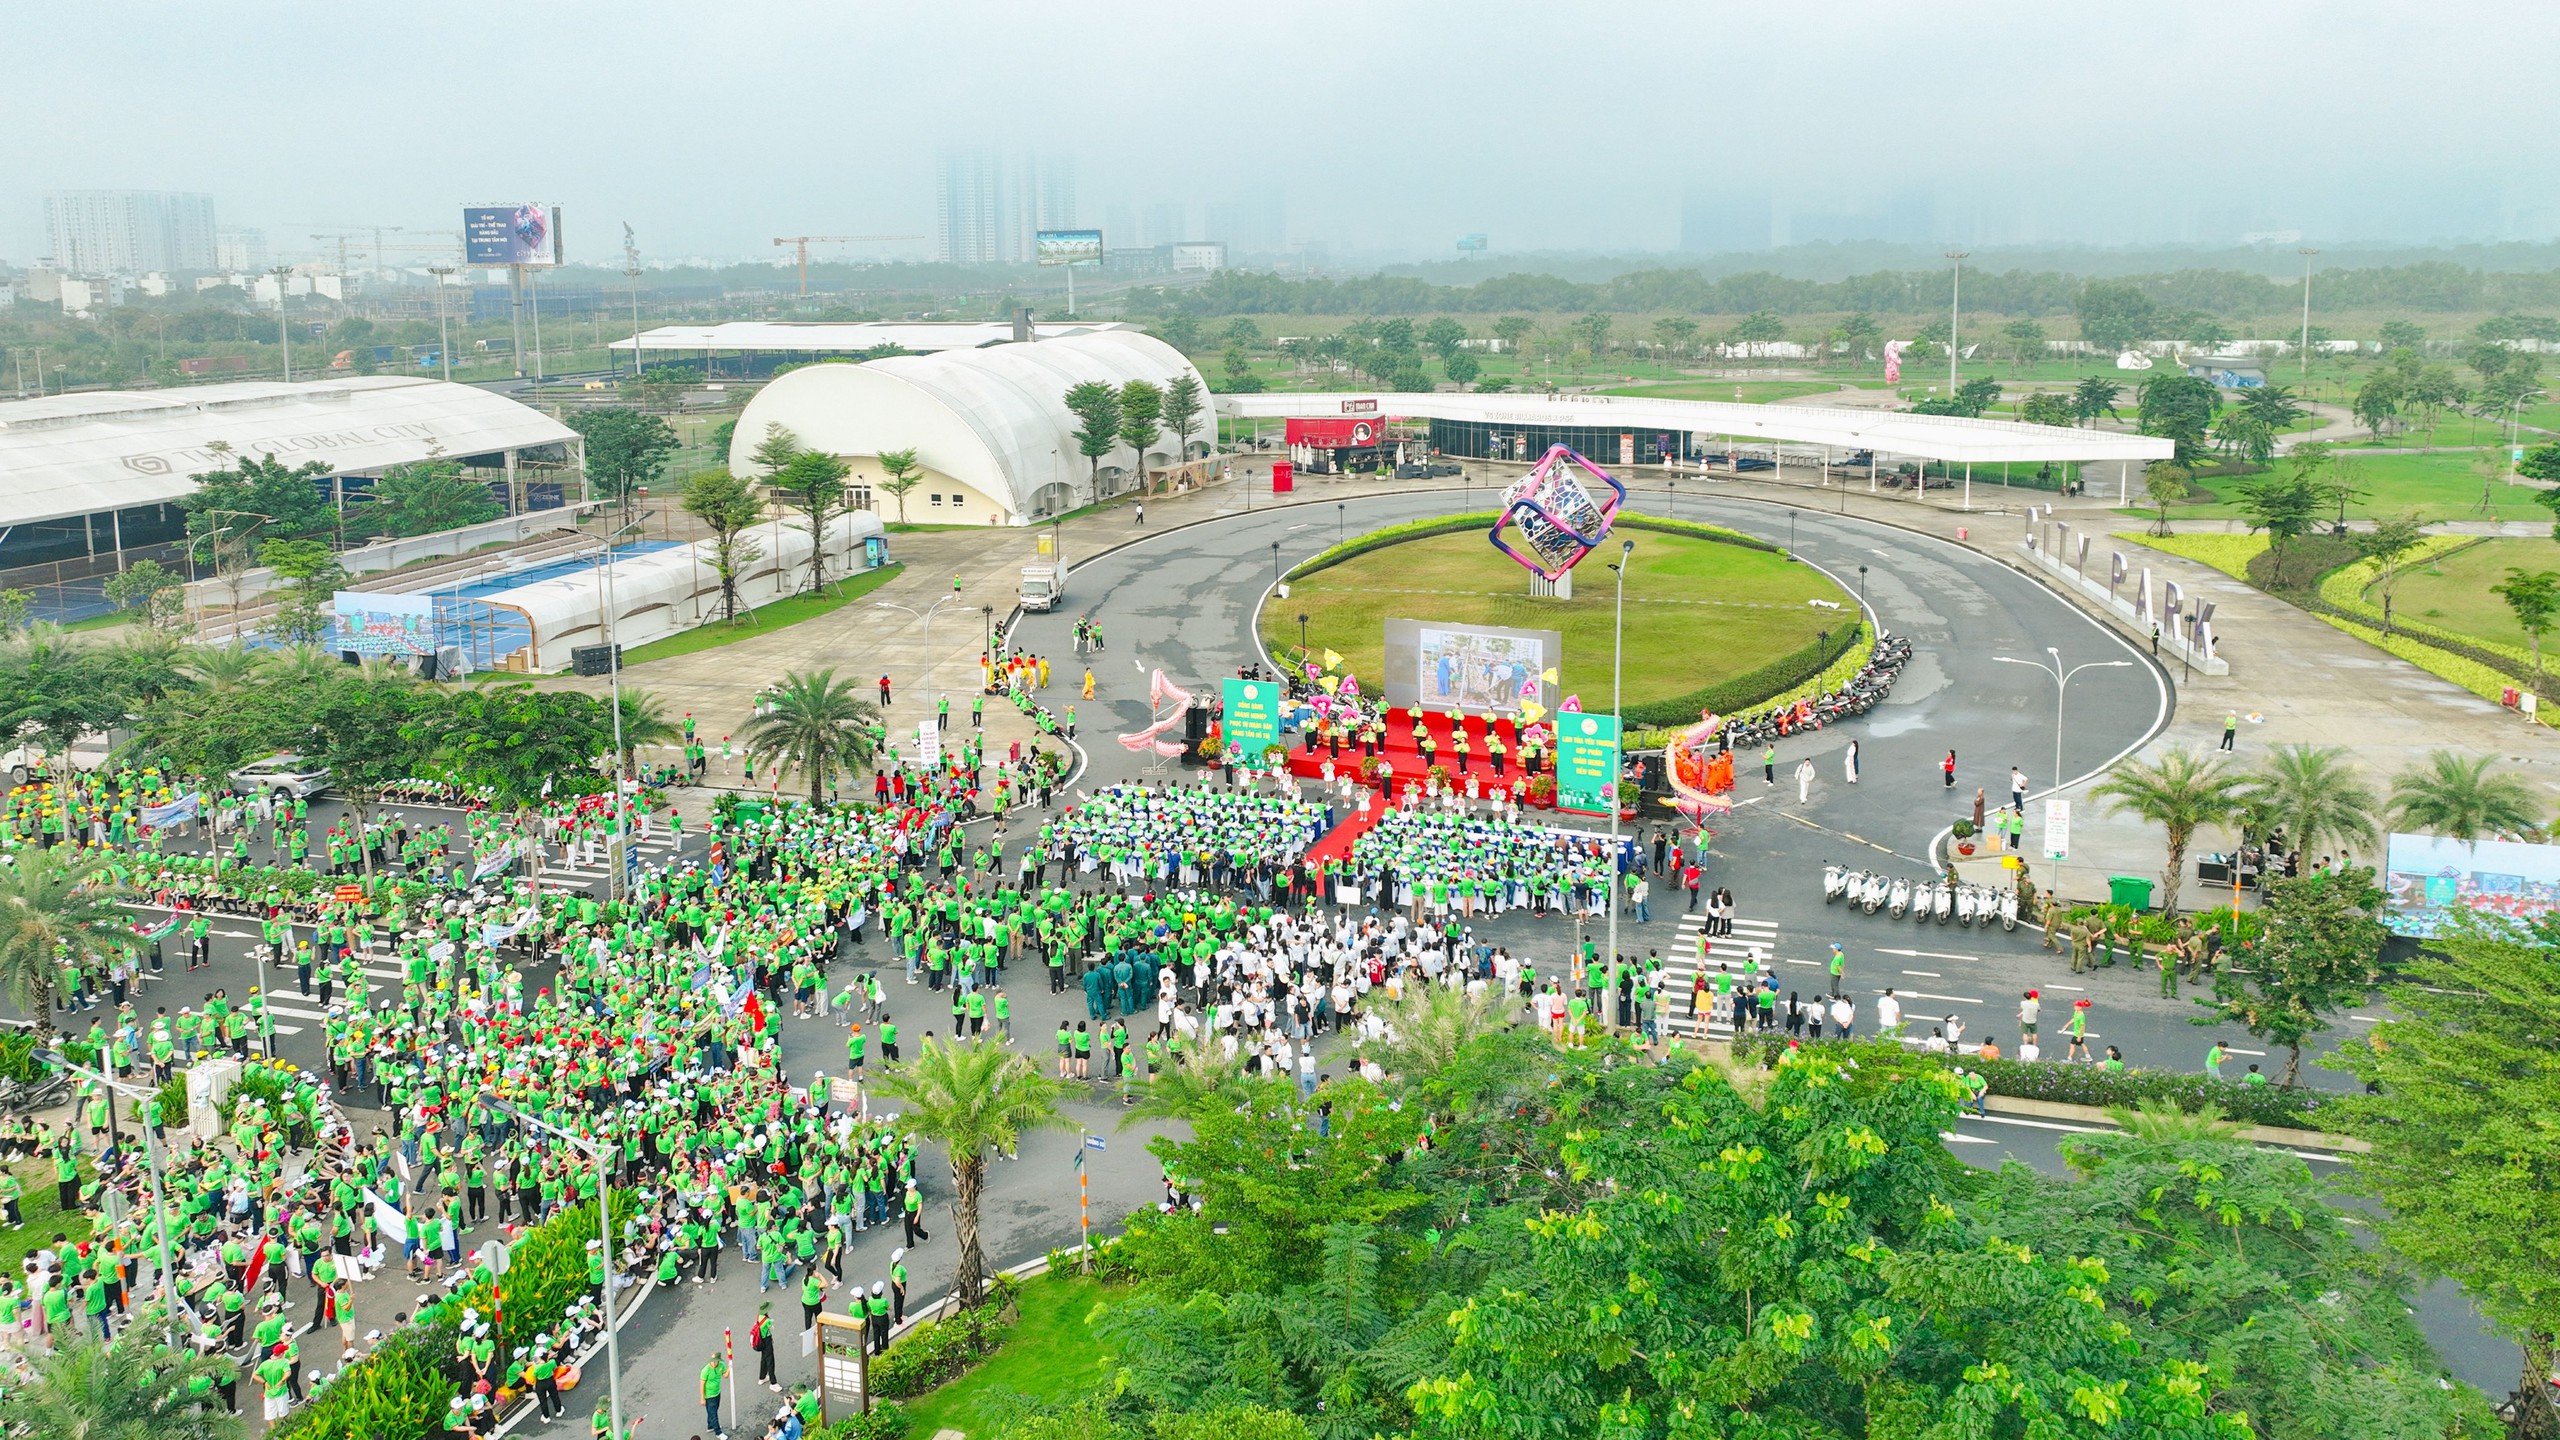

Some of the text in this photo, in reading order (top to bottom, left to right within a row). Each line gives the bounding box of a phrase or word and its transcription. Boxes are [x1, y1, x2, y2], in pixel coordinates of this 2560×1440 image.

[173, 422, 433, 463] THE GLOBAL CITY
[2111, 551, 2216, 660] PARK
